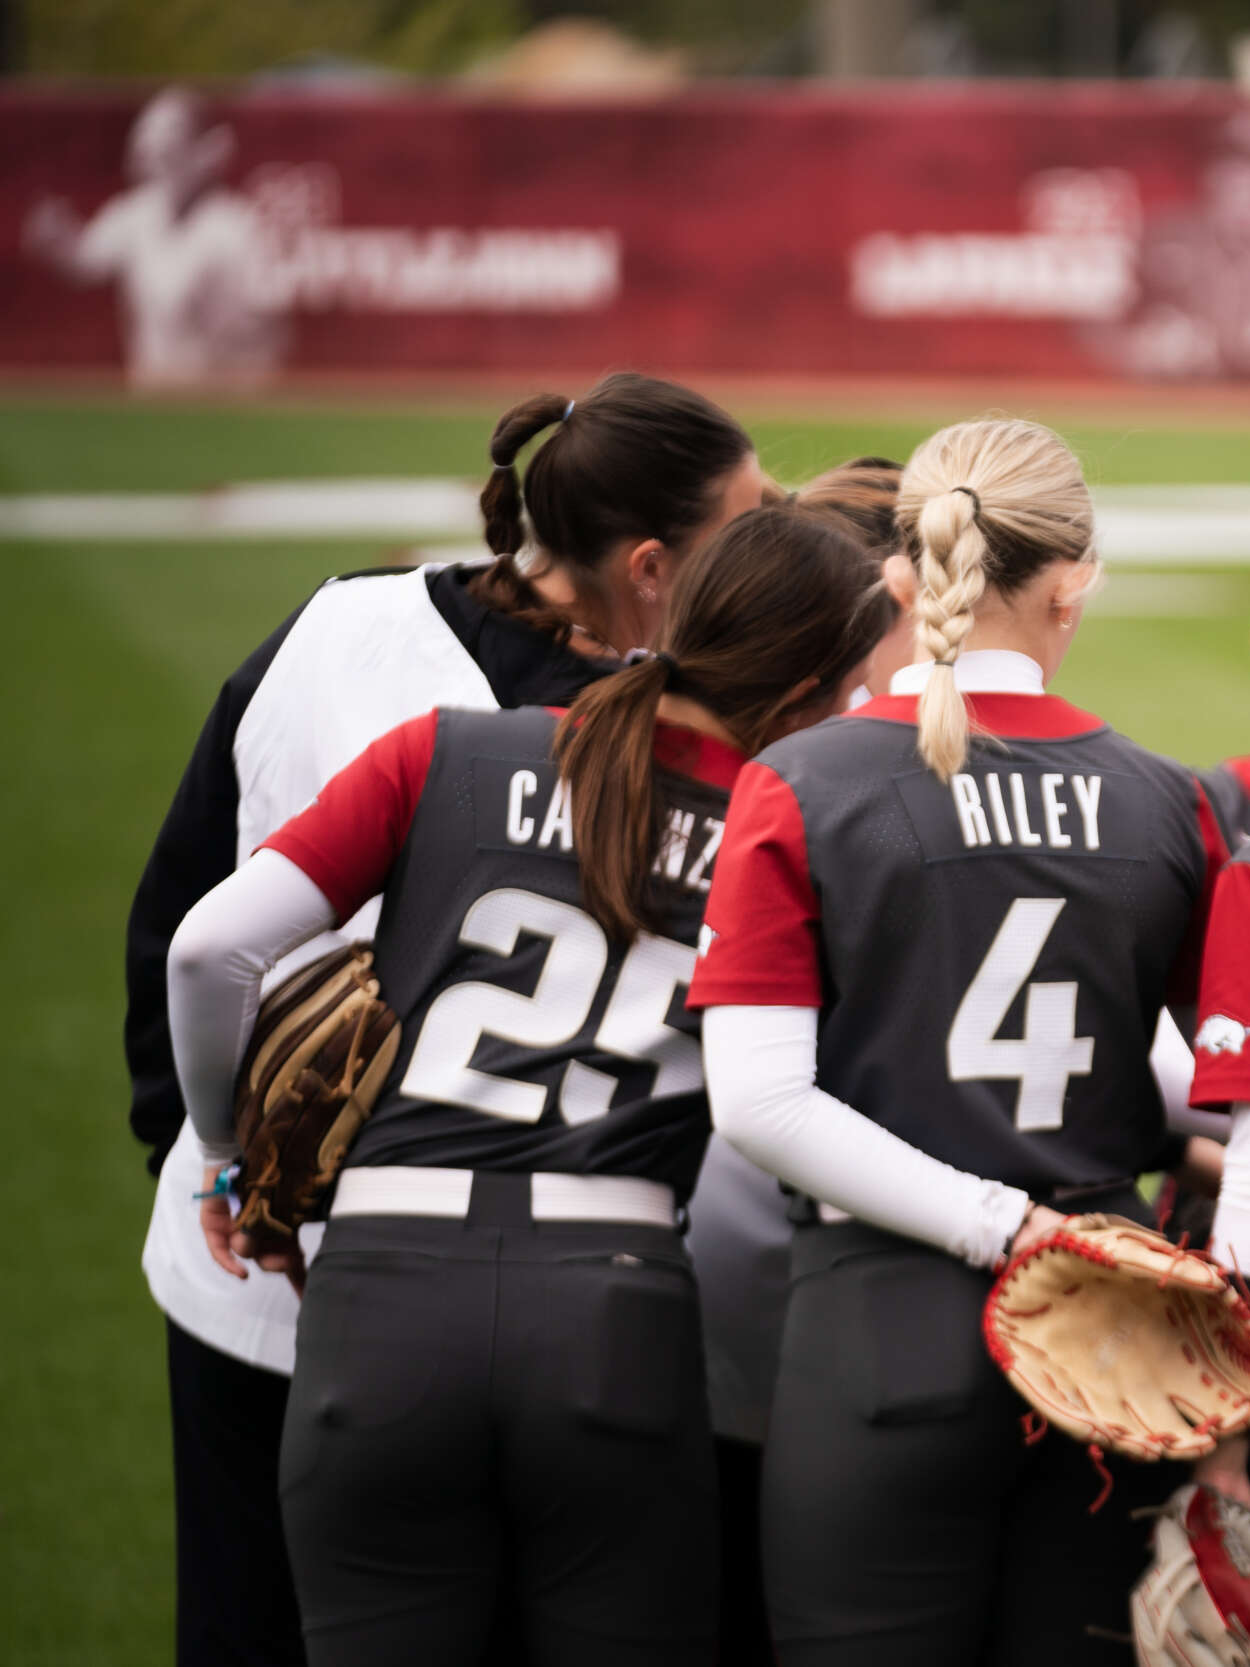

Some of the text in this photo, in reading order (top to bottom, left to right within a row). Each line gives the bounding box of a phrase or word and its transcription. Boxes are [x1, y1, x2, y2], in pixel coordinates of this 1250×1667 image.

[951, 772, 1103, 851] RILEY
[400, 886, 706, 1128] 25
[945, 896, 1096, 1132] 4
